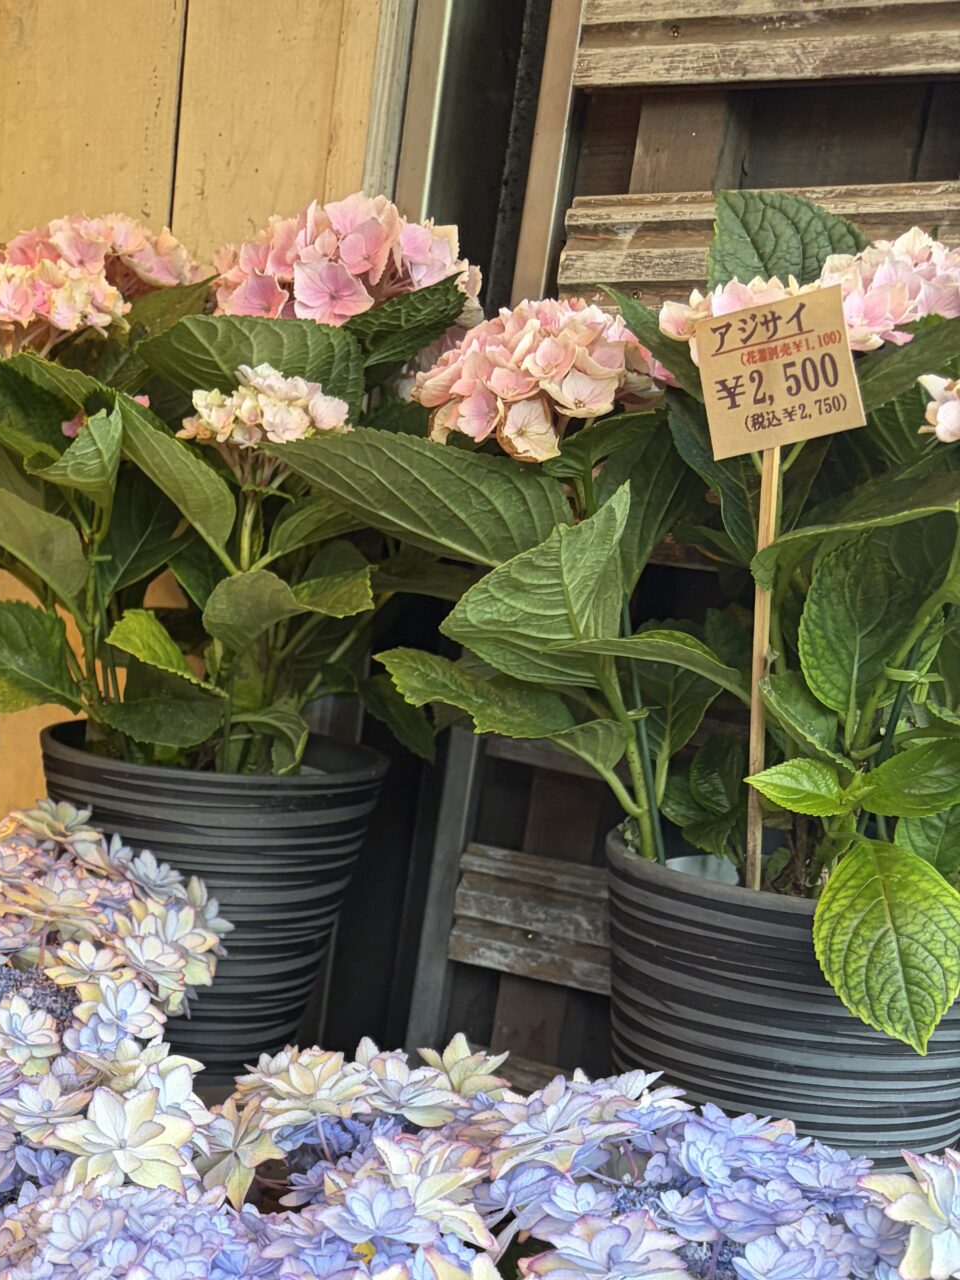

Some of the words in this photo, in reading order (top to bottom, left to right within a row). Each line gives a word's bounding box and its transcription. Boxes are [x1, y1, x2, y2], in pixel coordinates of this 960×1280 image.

[710, 302, 806, 353] アジサイ
[715, 352, 839, 410] ¥2,500
[744, 394, 847, 432] (税込¥2,750)
